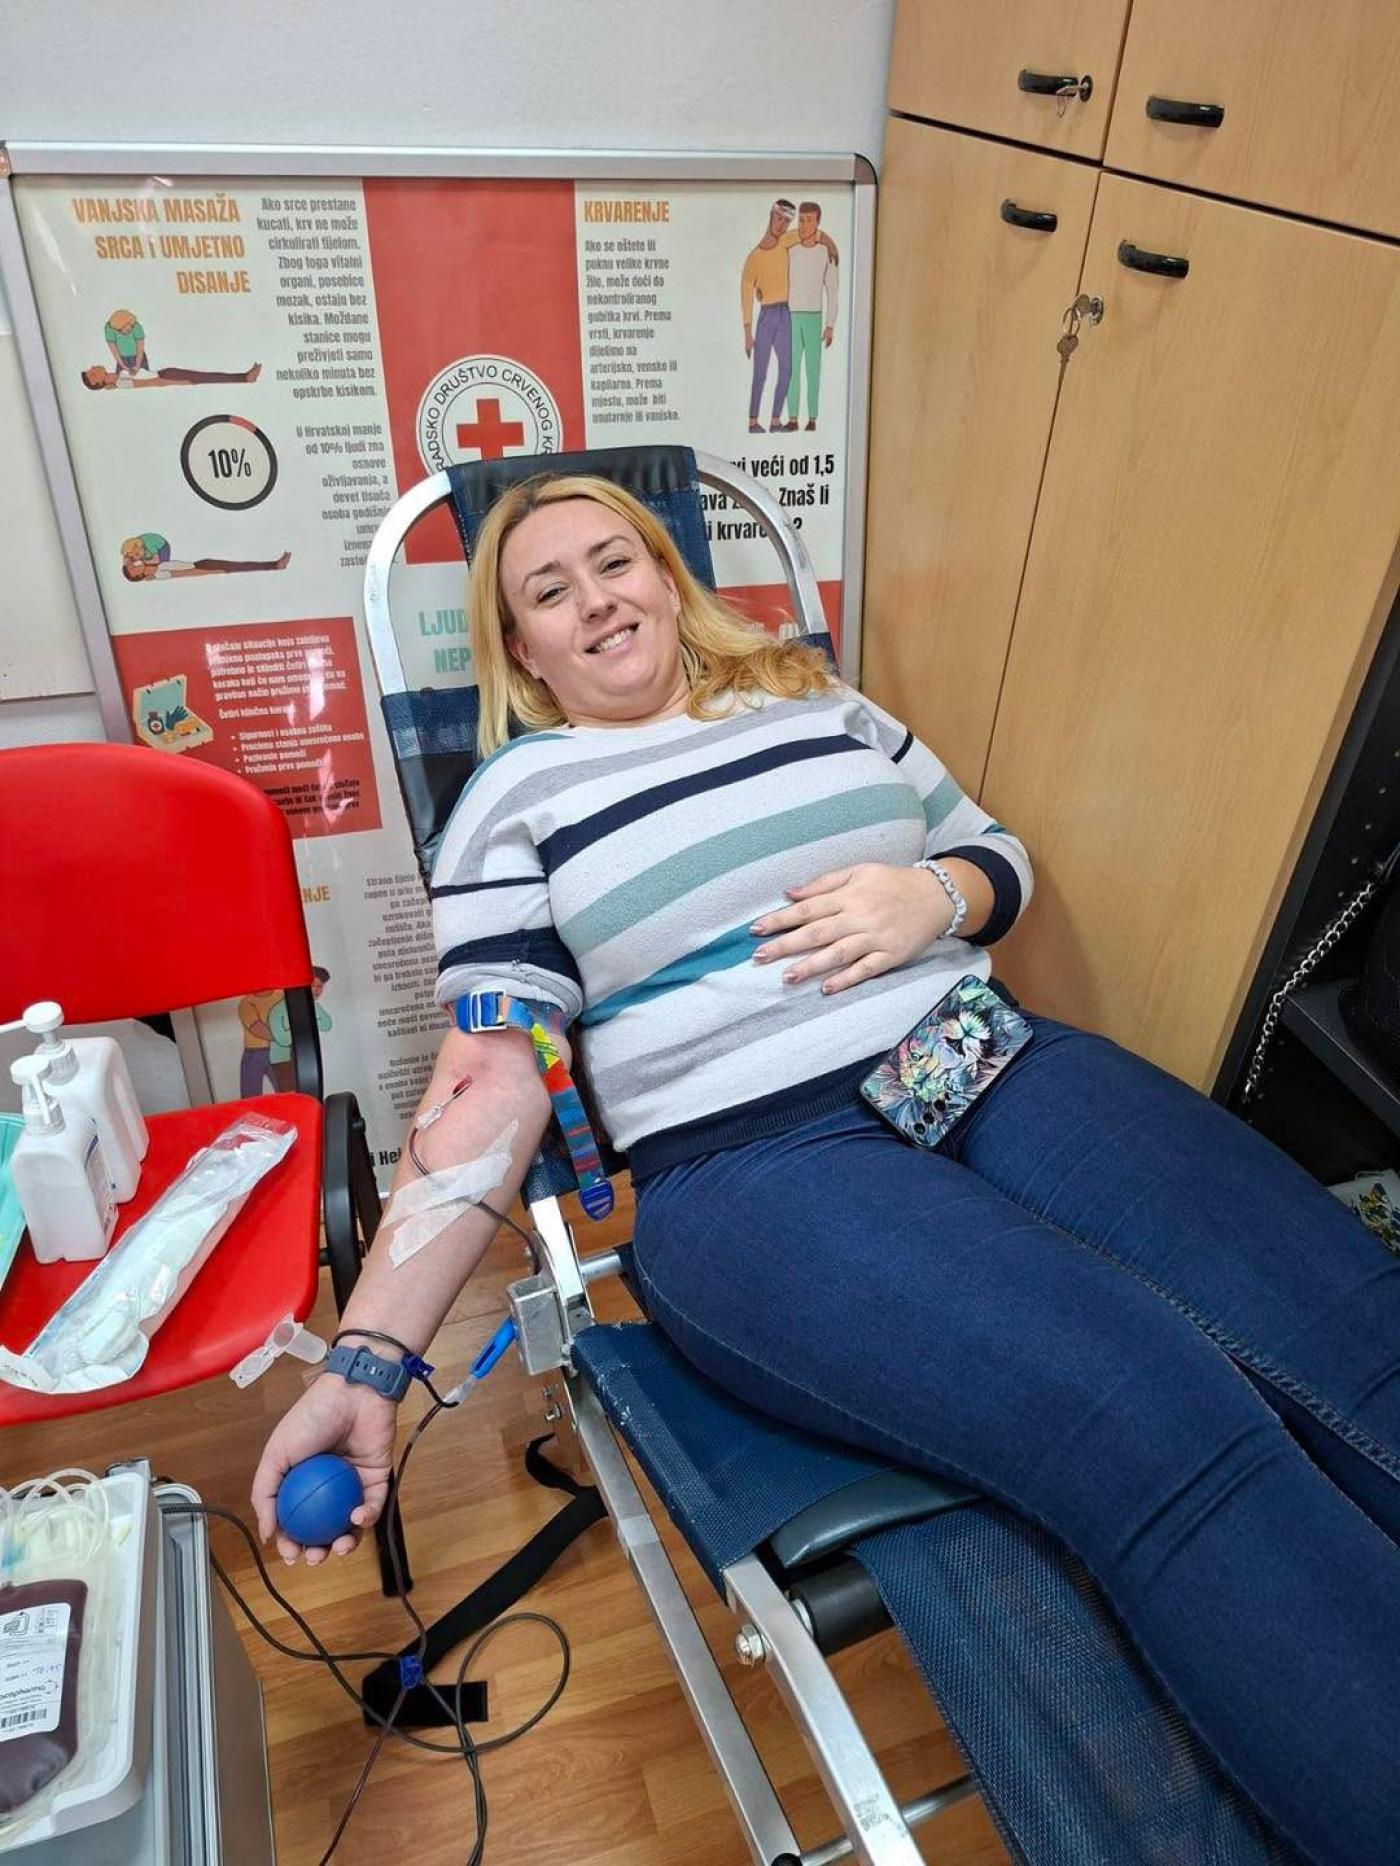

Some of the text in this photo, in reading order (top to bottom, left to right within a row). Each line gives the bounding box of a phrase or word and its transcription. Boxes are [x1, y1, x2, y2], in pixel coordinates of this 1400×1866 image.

[72, 193, 241, 223] VANJSKA MASAŽA
[261, 198, 357, 212] Ako srce prestane
[584, 201, 670, 222] KRVARENJE
[257, 216, 359, 231] kucati, krv ne može
[95, 235, 144, 259] SRCA
[160, 235, 246, 259] UMJETNO
[268, 236, 361, 250] cirkulirati tijelom.
[585, 240, 602, 251] Ako
[603, 241, 615, 252] se
[278, 255, 363, 270] Zbog toga vitalni
[585, 258, 670, 271] puknu velike krvne
[176, 271, 251, 294] DISANJE
[280, 274, 365, 289] organi, posebice
[606, 274, 630, 287] može
[632, 274, 651, 287] doći
[653, 275, 664, 287] do
[276, 293, 367, 307] mozak, ostaju bez
[587, 292, 657, 305] nekontroliranog
[323, 310, 369, 325] Moždane
[588, 310, 621, 324] gubitka
[644, 310, 672, 321] Prema
[302, 331, 372, 344] stanice mogu
[613, 327, 654, 339] krvarenje
[297, 348, 373, 363] preživjeti samo
[626, 346, 637, 356] na
[636, 360, 667, 372] vensko
[276, 367, 376, 380] nekoliko minuta bez
[635, 379, 662, 389] Prema
[293, 386, 334, 400] opskrbe
[433, 364, 498, 405] DRUŠTVO
[501, 369, 553, 431] CRVENOG
[625, 394, 648, 405] može
[305, 424, 350, 437] Hrvatskoj
[352, 422, 382, 436] manje
[368, 442, 385, 452] zna
[208, 448, 252, 478] 10%
[352, 459, 386, 469] osnove
[751, 455, 784, 477] veći
[790, 455, 809, 475] od
[813, 454, 835, 477] 1,5
[333, 491, 359, 503] devet
[779, 482, 829, 507] Znaš li
[322, 508, 351, 519] osoba
